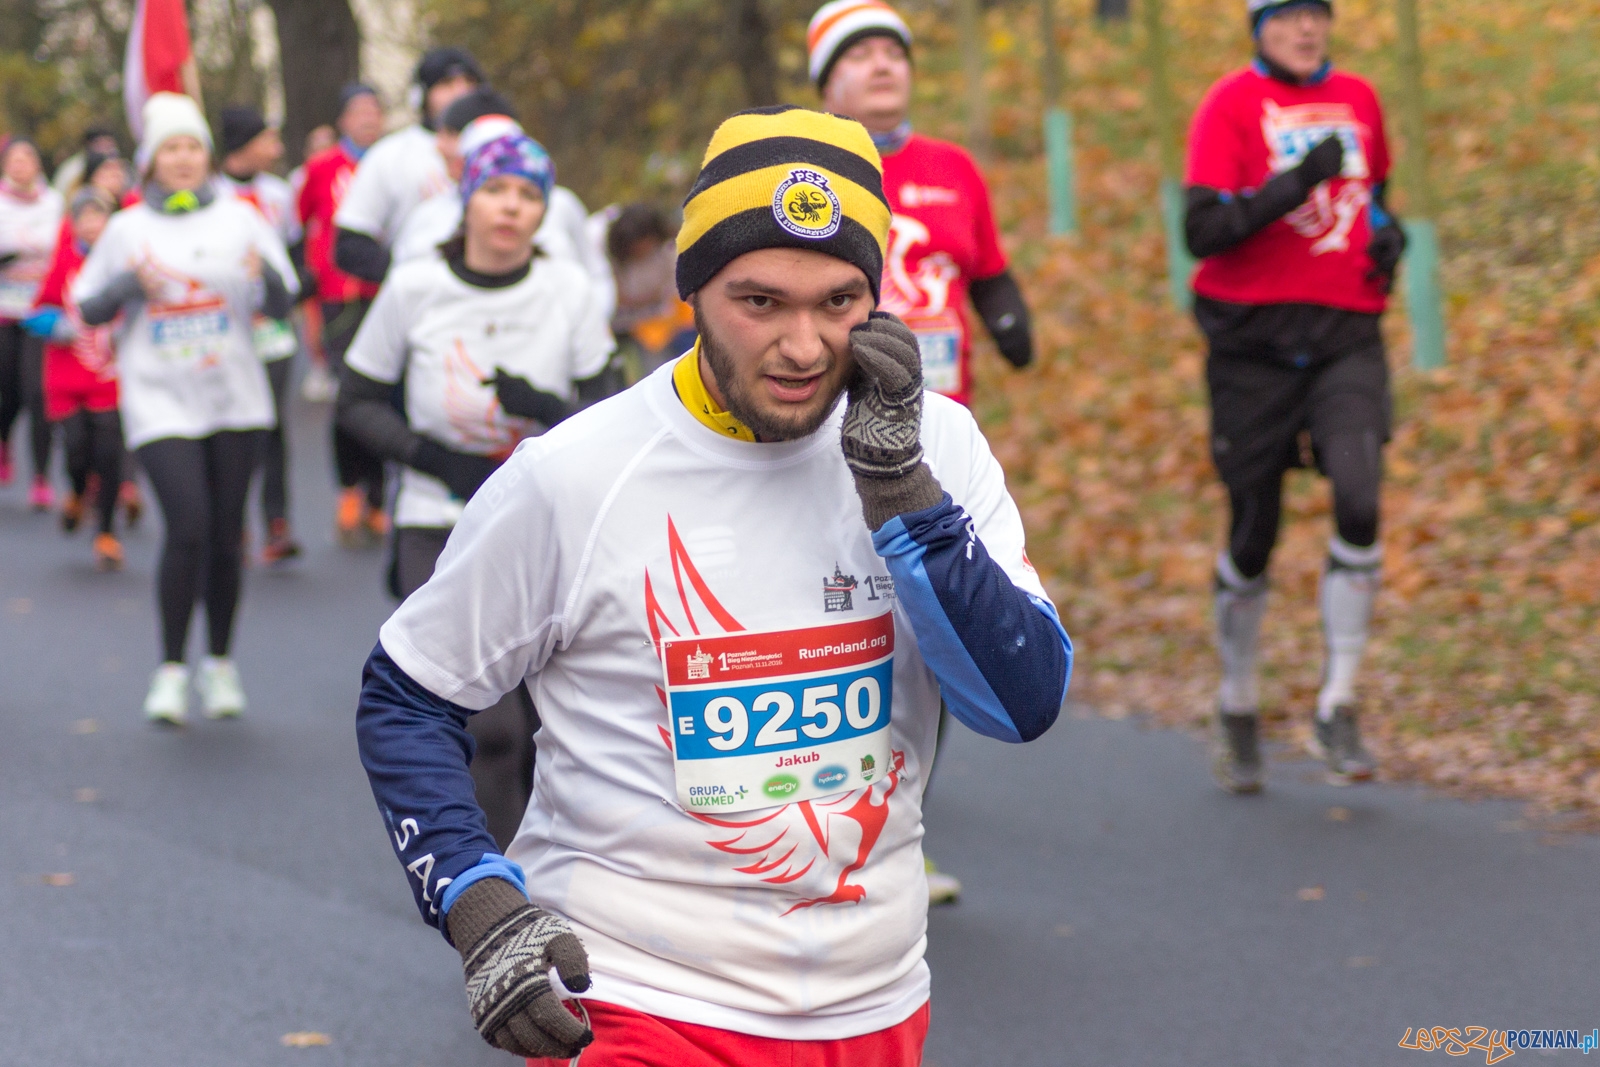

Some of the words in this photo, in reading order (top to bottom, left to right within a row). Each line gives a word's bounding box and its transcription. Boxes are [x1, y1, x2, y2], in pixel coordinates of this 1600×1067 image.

[799, 635, 887, 660] RunPoland.org
[717, 652, 730, 671] 1
[678, 716, 695, 735] E
[703, 676, 881, 751] 9250
[775, 751, 820, 768] Jakub
[689, 785, 727, 796] GRUPA
[690, 795, 735, 806] LUXMED
